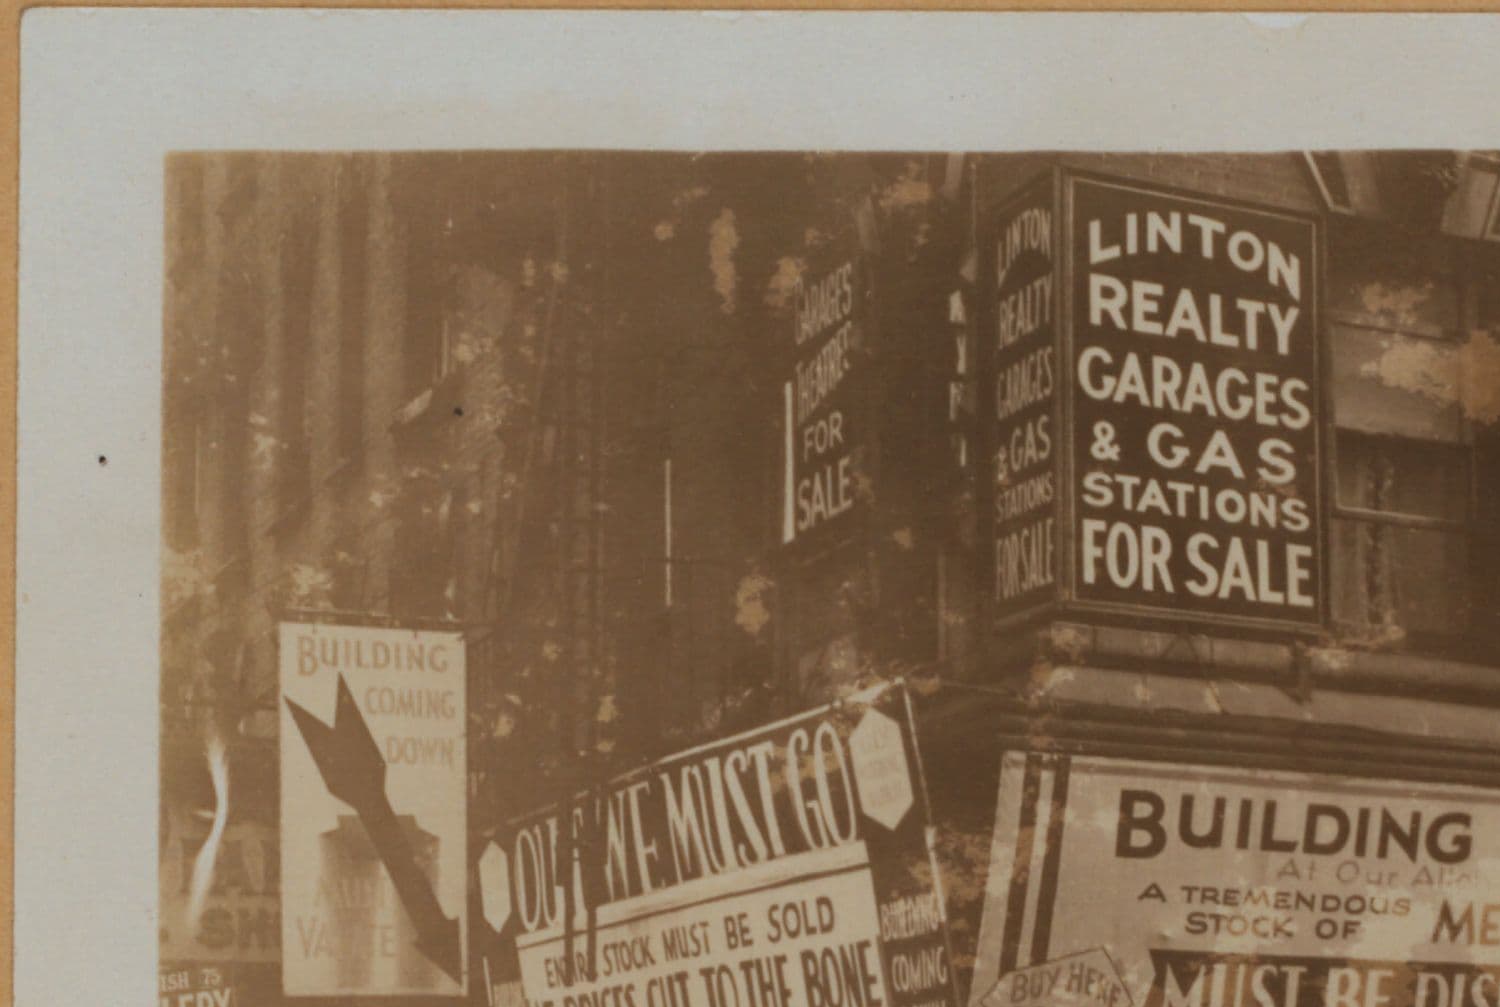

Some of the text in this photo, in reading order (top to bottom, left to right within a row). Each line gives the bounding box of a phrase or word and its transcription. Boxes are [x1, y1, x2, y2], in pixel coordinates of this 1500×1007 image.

[1089, 211, 1301, 299] LINTON
[999, 273, 1054, 349] REALTY
[1089, 272, 1300, 356] REALTY
[1077, 346, 1311, 430] GARAGES
[803, 409, 845, 464] FOR
[1010, 414, 1052, 475] GAS
[1091, 421, 1297, 486] & GAS
[796, 456, 855, 533] SALE
[1082, 471, 1311, 532] STATIONS
[1082, 518, 1315, 608] FOR SALE
[296, 636, 450, 678] BUILDING
[363, 686, 457, 722] COMING
[385, 735, 456, 770] DOWN
[658, 739, 788, 887] MUST
[786, 719, 859, 851] GO
[1113, 787, 1473, 865] BUILDING
[1138, 882, 1412, 918] A TREMENDOUS
[1184, 910, 1363, 942] STOCK OF
[602, 937, 656, 978] STOCK
[662, 919, 711, 963] MUST
[723, 912, 755, 951] BE
[766, 895, 836, 944] SOLD
[890, 947, 948, 992] COMING
[1011, 965, 1061, 1003] BUY
